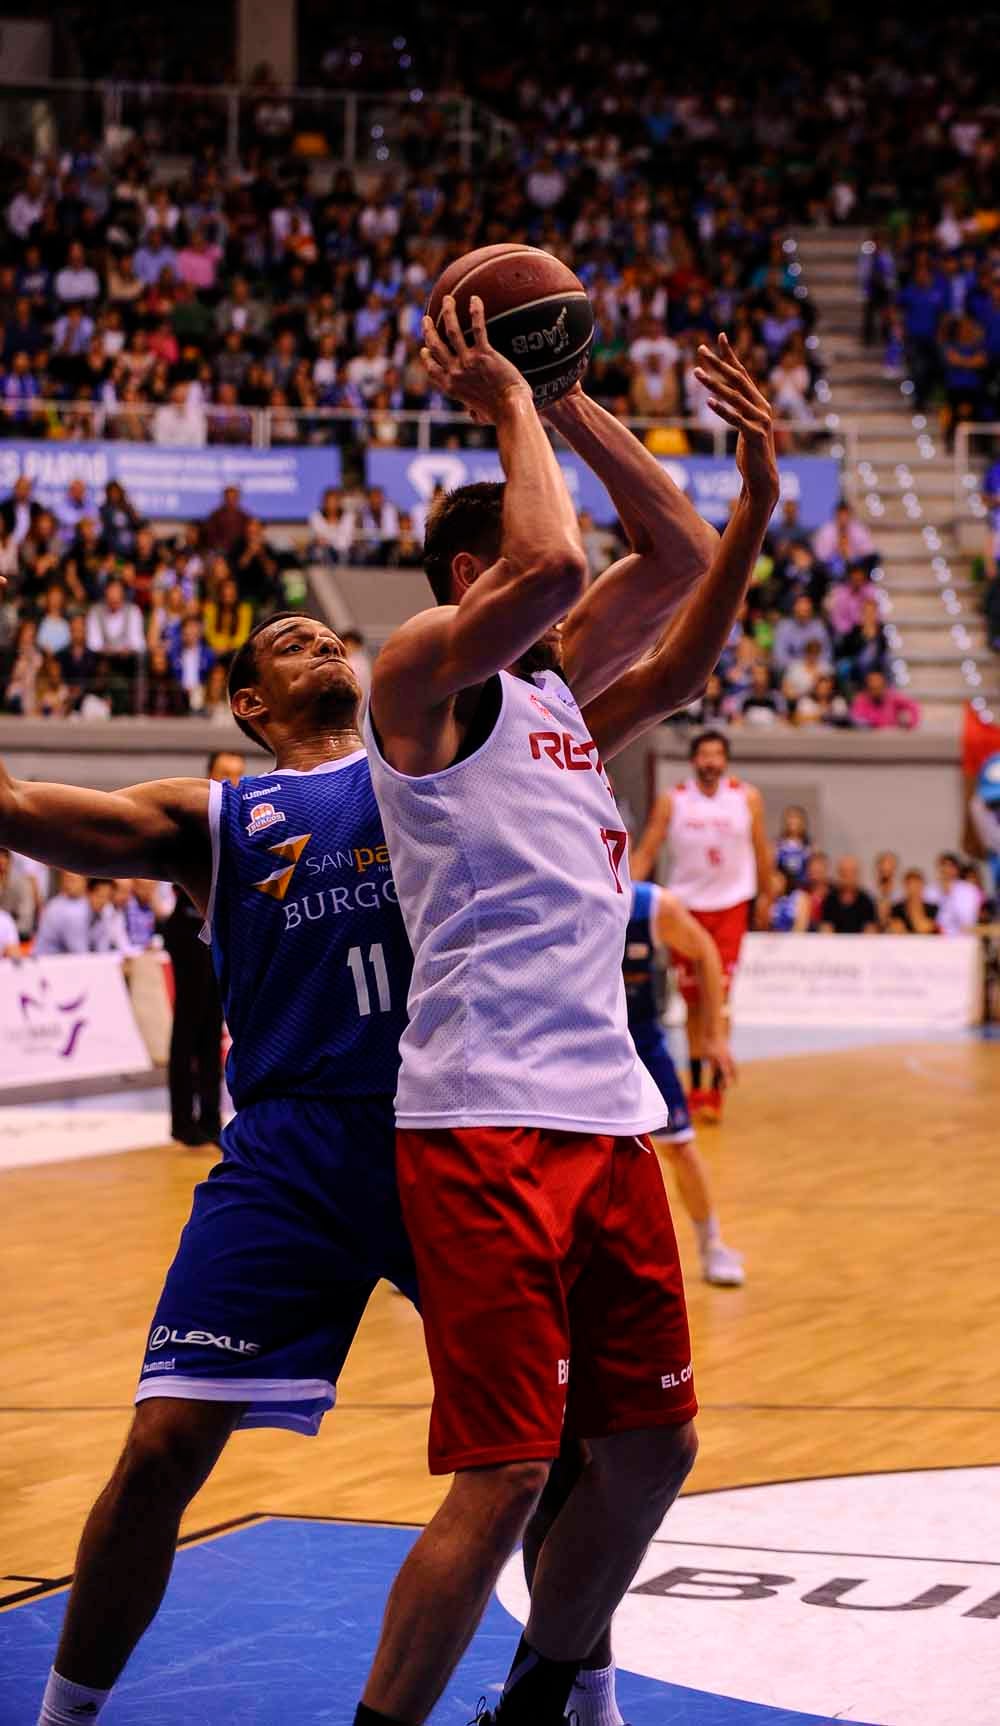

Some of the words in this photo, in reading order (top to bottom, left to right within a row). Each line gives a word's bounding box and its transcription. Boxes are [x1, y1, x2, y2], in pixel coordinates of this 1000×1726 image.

[346, 942, 391, 1017] 11
[170, 1329, 261, 1356] LEXUS
[660, 1373, 680, 1389] EL
